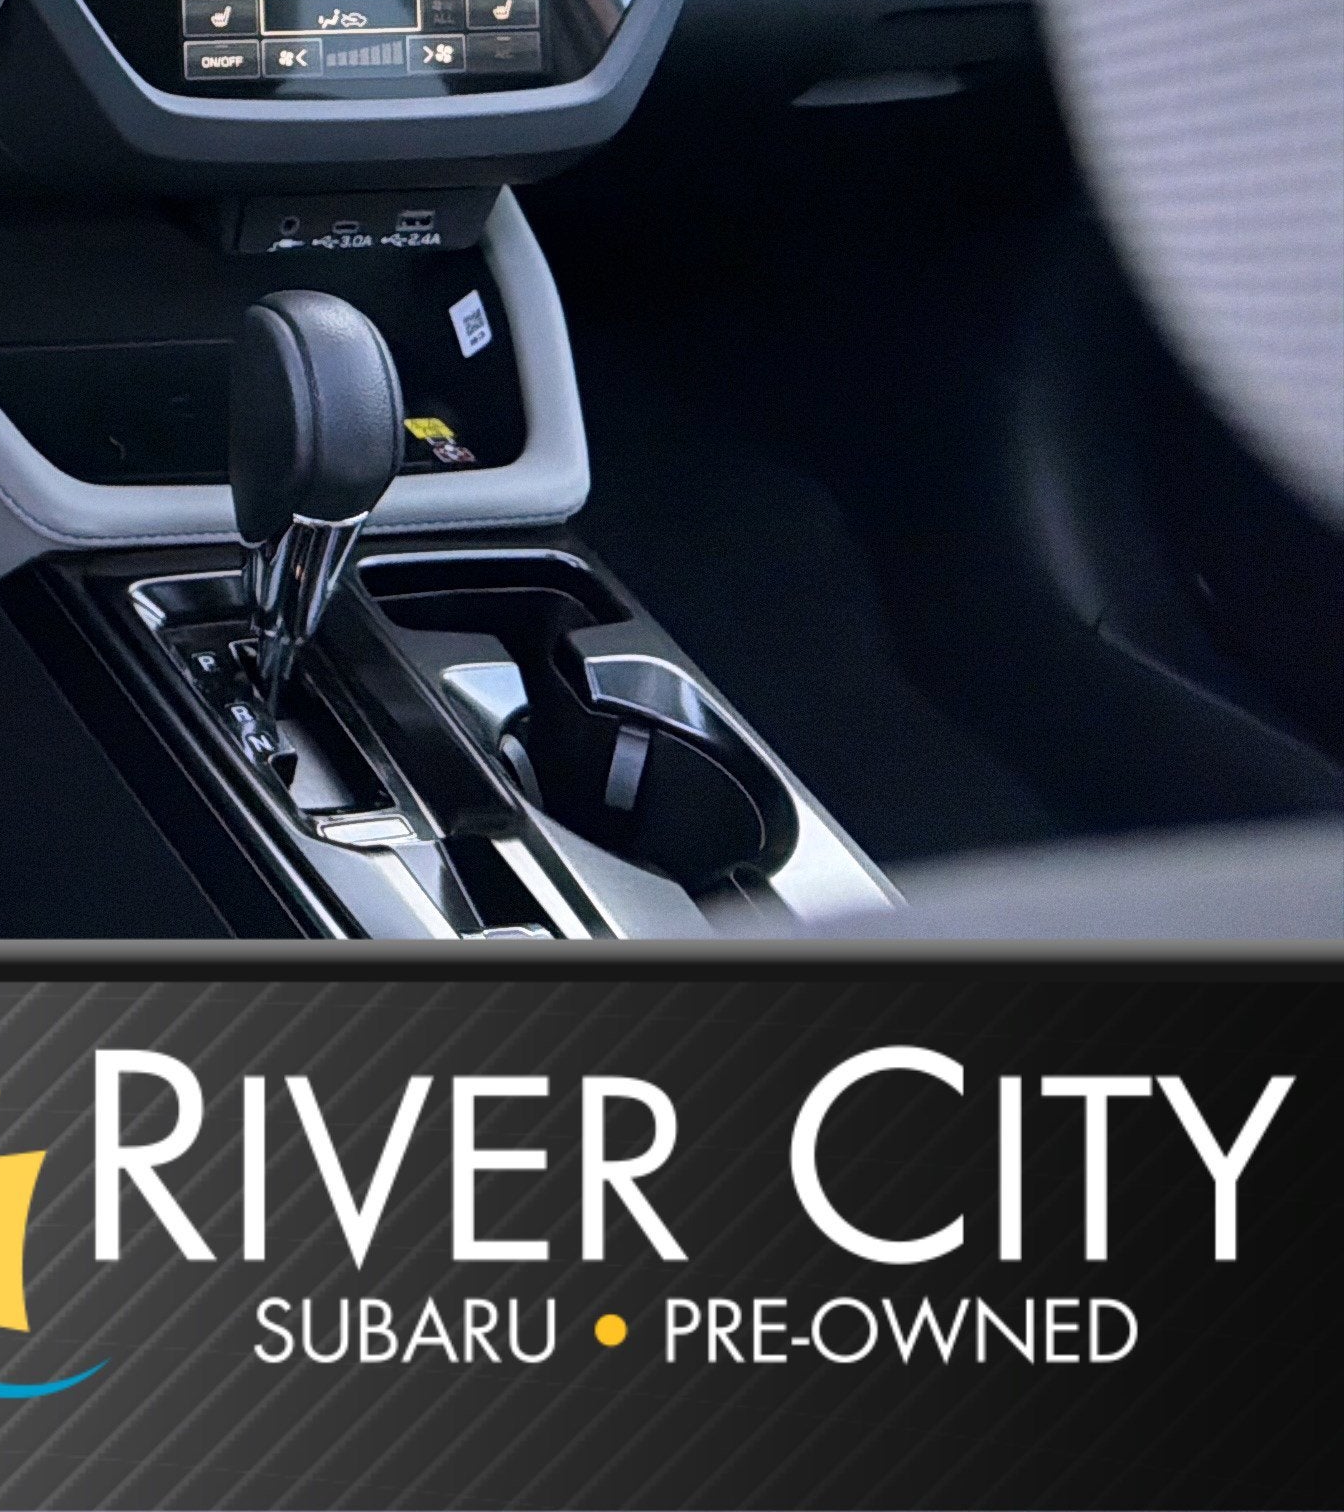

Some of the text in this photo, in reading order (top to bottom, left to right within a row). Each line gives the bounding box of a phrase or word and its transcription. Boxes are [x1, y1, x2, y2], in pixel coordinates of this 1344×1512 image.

[201, 55, 244, 68] ON/OFF
[230, 705, 254, 724] R
[247, 734, 275, 753] N
